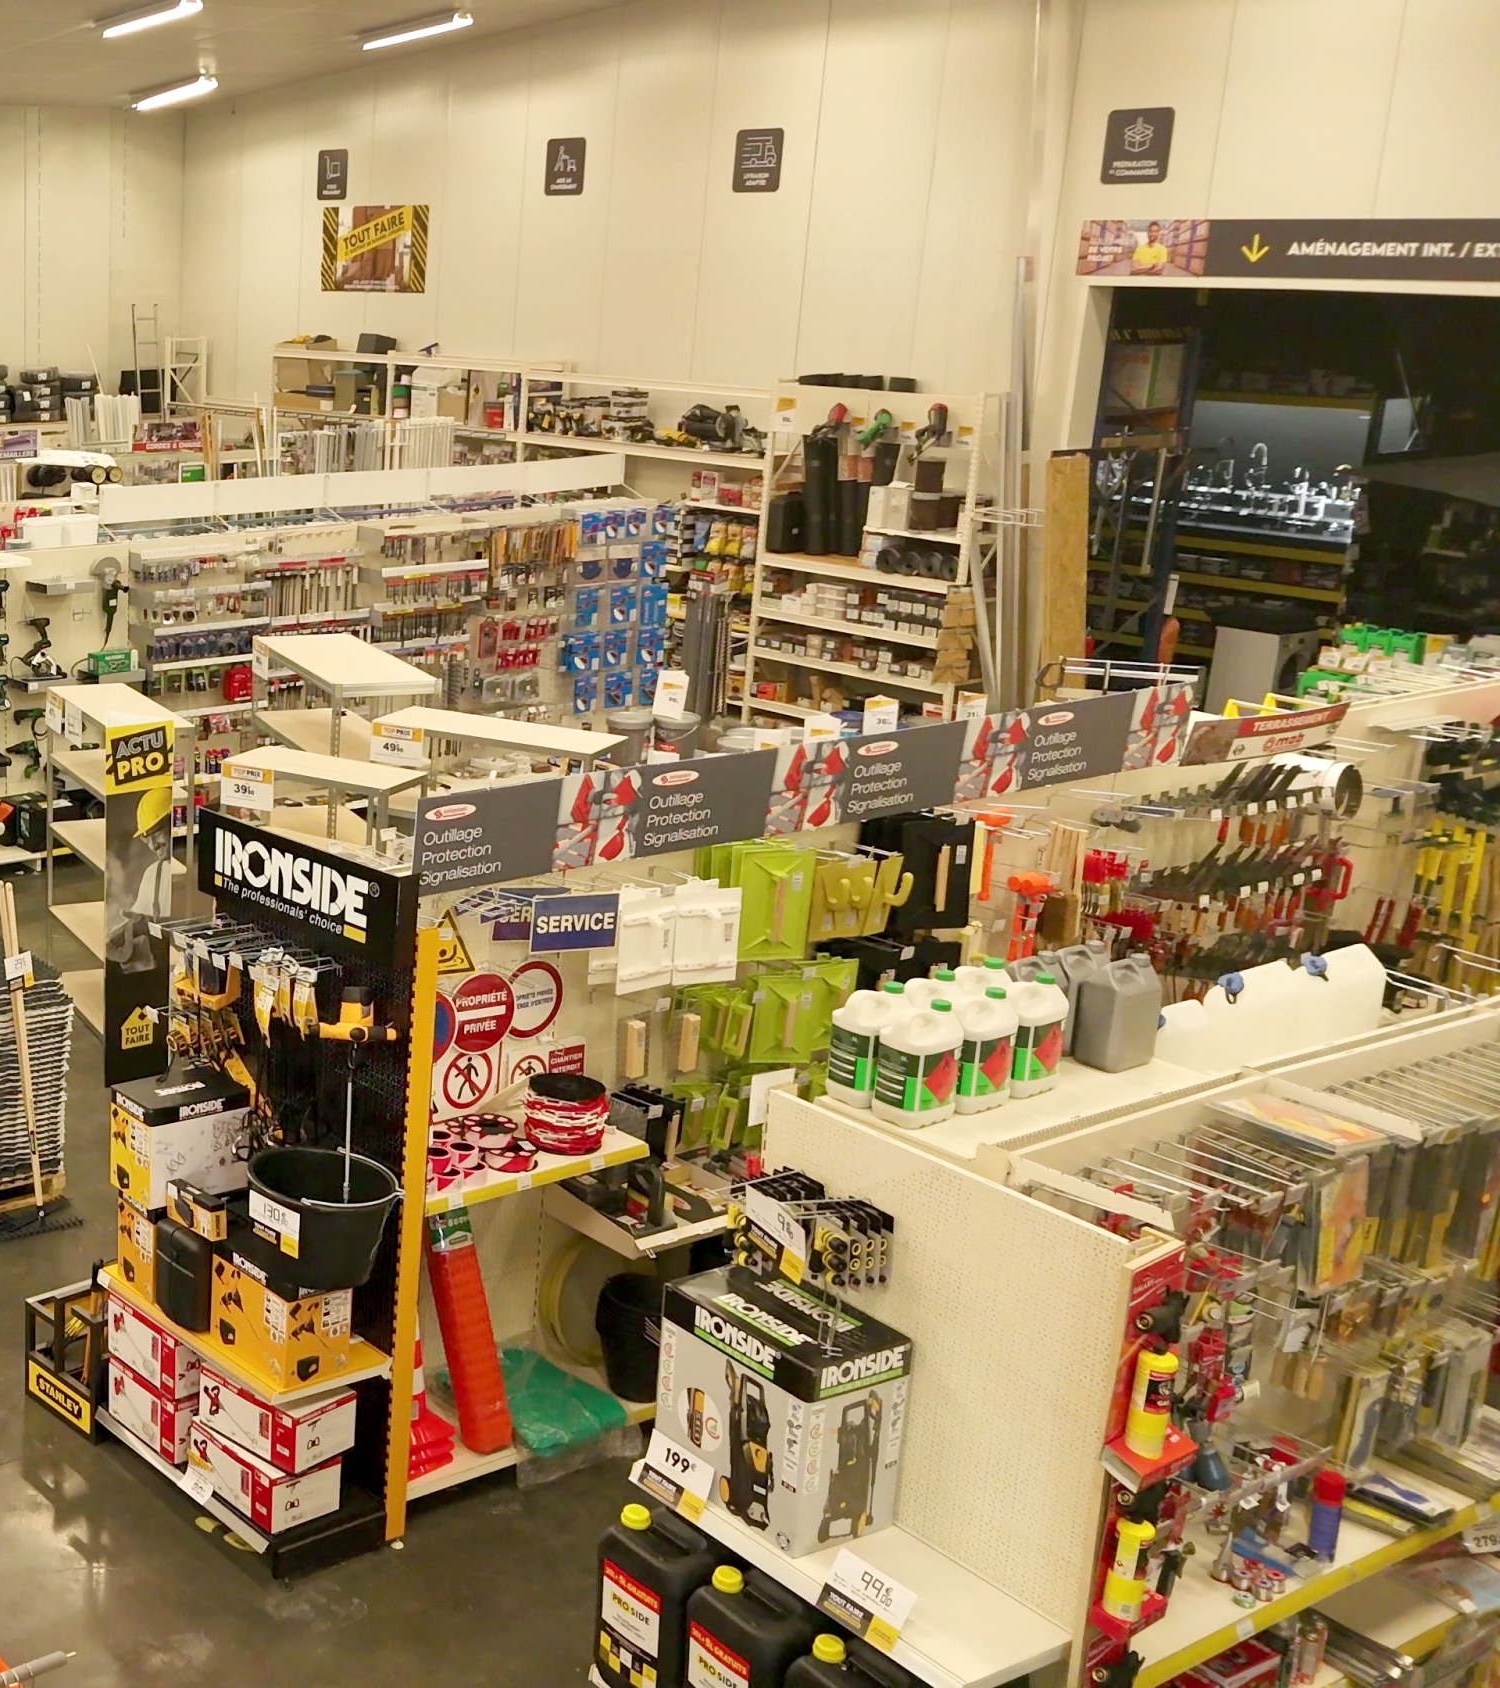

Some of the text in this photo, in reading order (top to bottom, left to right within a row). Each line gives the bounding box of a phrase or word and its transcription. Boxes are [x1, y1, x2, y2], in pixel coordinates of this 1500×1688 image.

[343, 212, 405, 250] TOUT FAIRE
[1286, 238, 1420, 256] AMÉNAGEMENT
[1422, 241, 1456, 257] INT.
[1253, 711, 1330, 731] TERRASSEMENT
[115, 730, 164, 759] ACTU
[1033, 729, 1077, 748] Outillage
[117, 751, 164, 780] PRO
[1030, 745, 1083, 764] Protection
[246, 770, 261, 778] PRIX
[853, 759, 903, 779] Outillage
[1027, 760, 1087, 782] Signalisation
[850, 775, 908, 796] Protection
[648, 790, 704, 810] Outillage
[846, 791, 914, 815] Signalisation
[645, 807, 711, 828] Protection
[422, 825, 483, 846] Outillage
[643, 823, 719, 848] Signalisation
[421, 842, 492, 865] Protection
[214, 827, 369, 929] IRONSIDE
[419, 860, 502, 887] Signalisation
[222, 878, 240, 895] The
[308, 912, 343, 935] choice
[536, 911, 615, 935] SERVICE
[455, 987, 508, 1008] PROPRIÉTÉ
[124, 1023, 150, 1037] TOUT
[463, 1018, 497, 1034] PRIVÉE
[124, 1033, 151, 1046] FAIRE
[550, 1052, 583, 1065] CHANTIER
[179, 1098, 226, 1119] IRONSIDE
[760, 1279, 857, 1334] IRONSIDE
[717, 1292, 807, 1346] IRONSIDE
[694, 1305, 777, 1372] IRONSIDE
[820, 1344, 905, 1389] IRONSIDE
[37, 1376, 81, 1417] STANLEY
[627, 1582, 659, 1609] GRATUITS
[612, 1592, 650, 1626] PRO SIDE
[699, 1655, 716, 1676] PRO
[714, 1644, 748, 1676] GRATUITS
